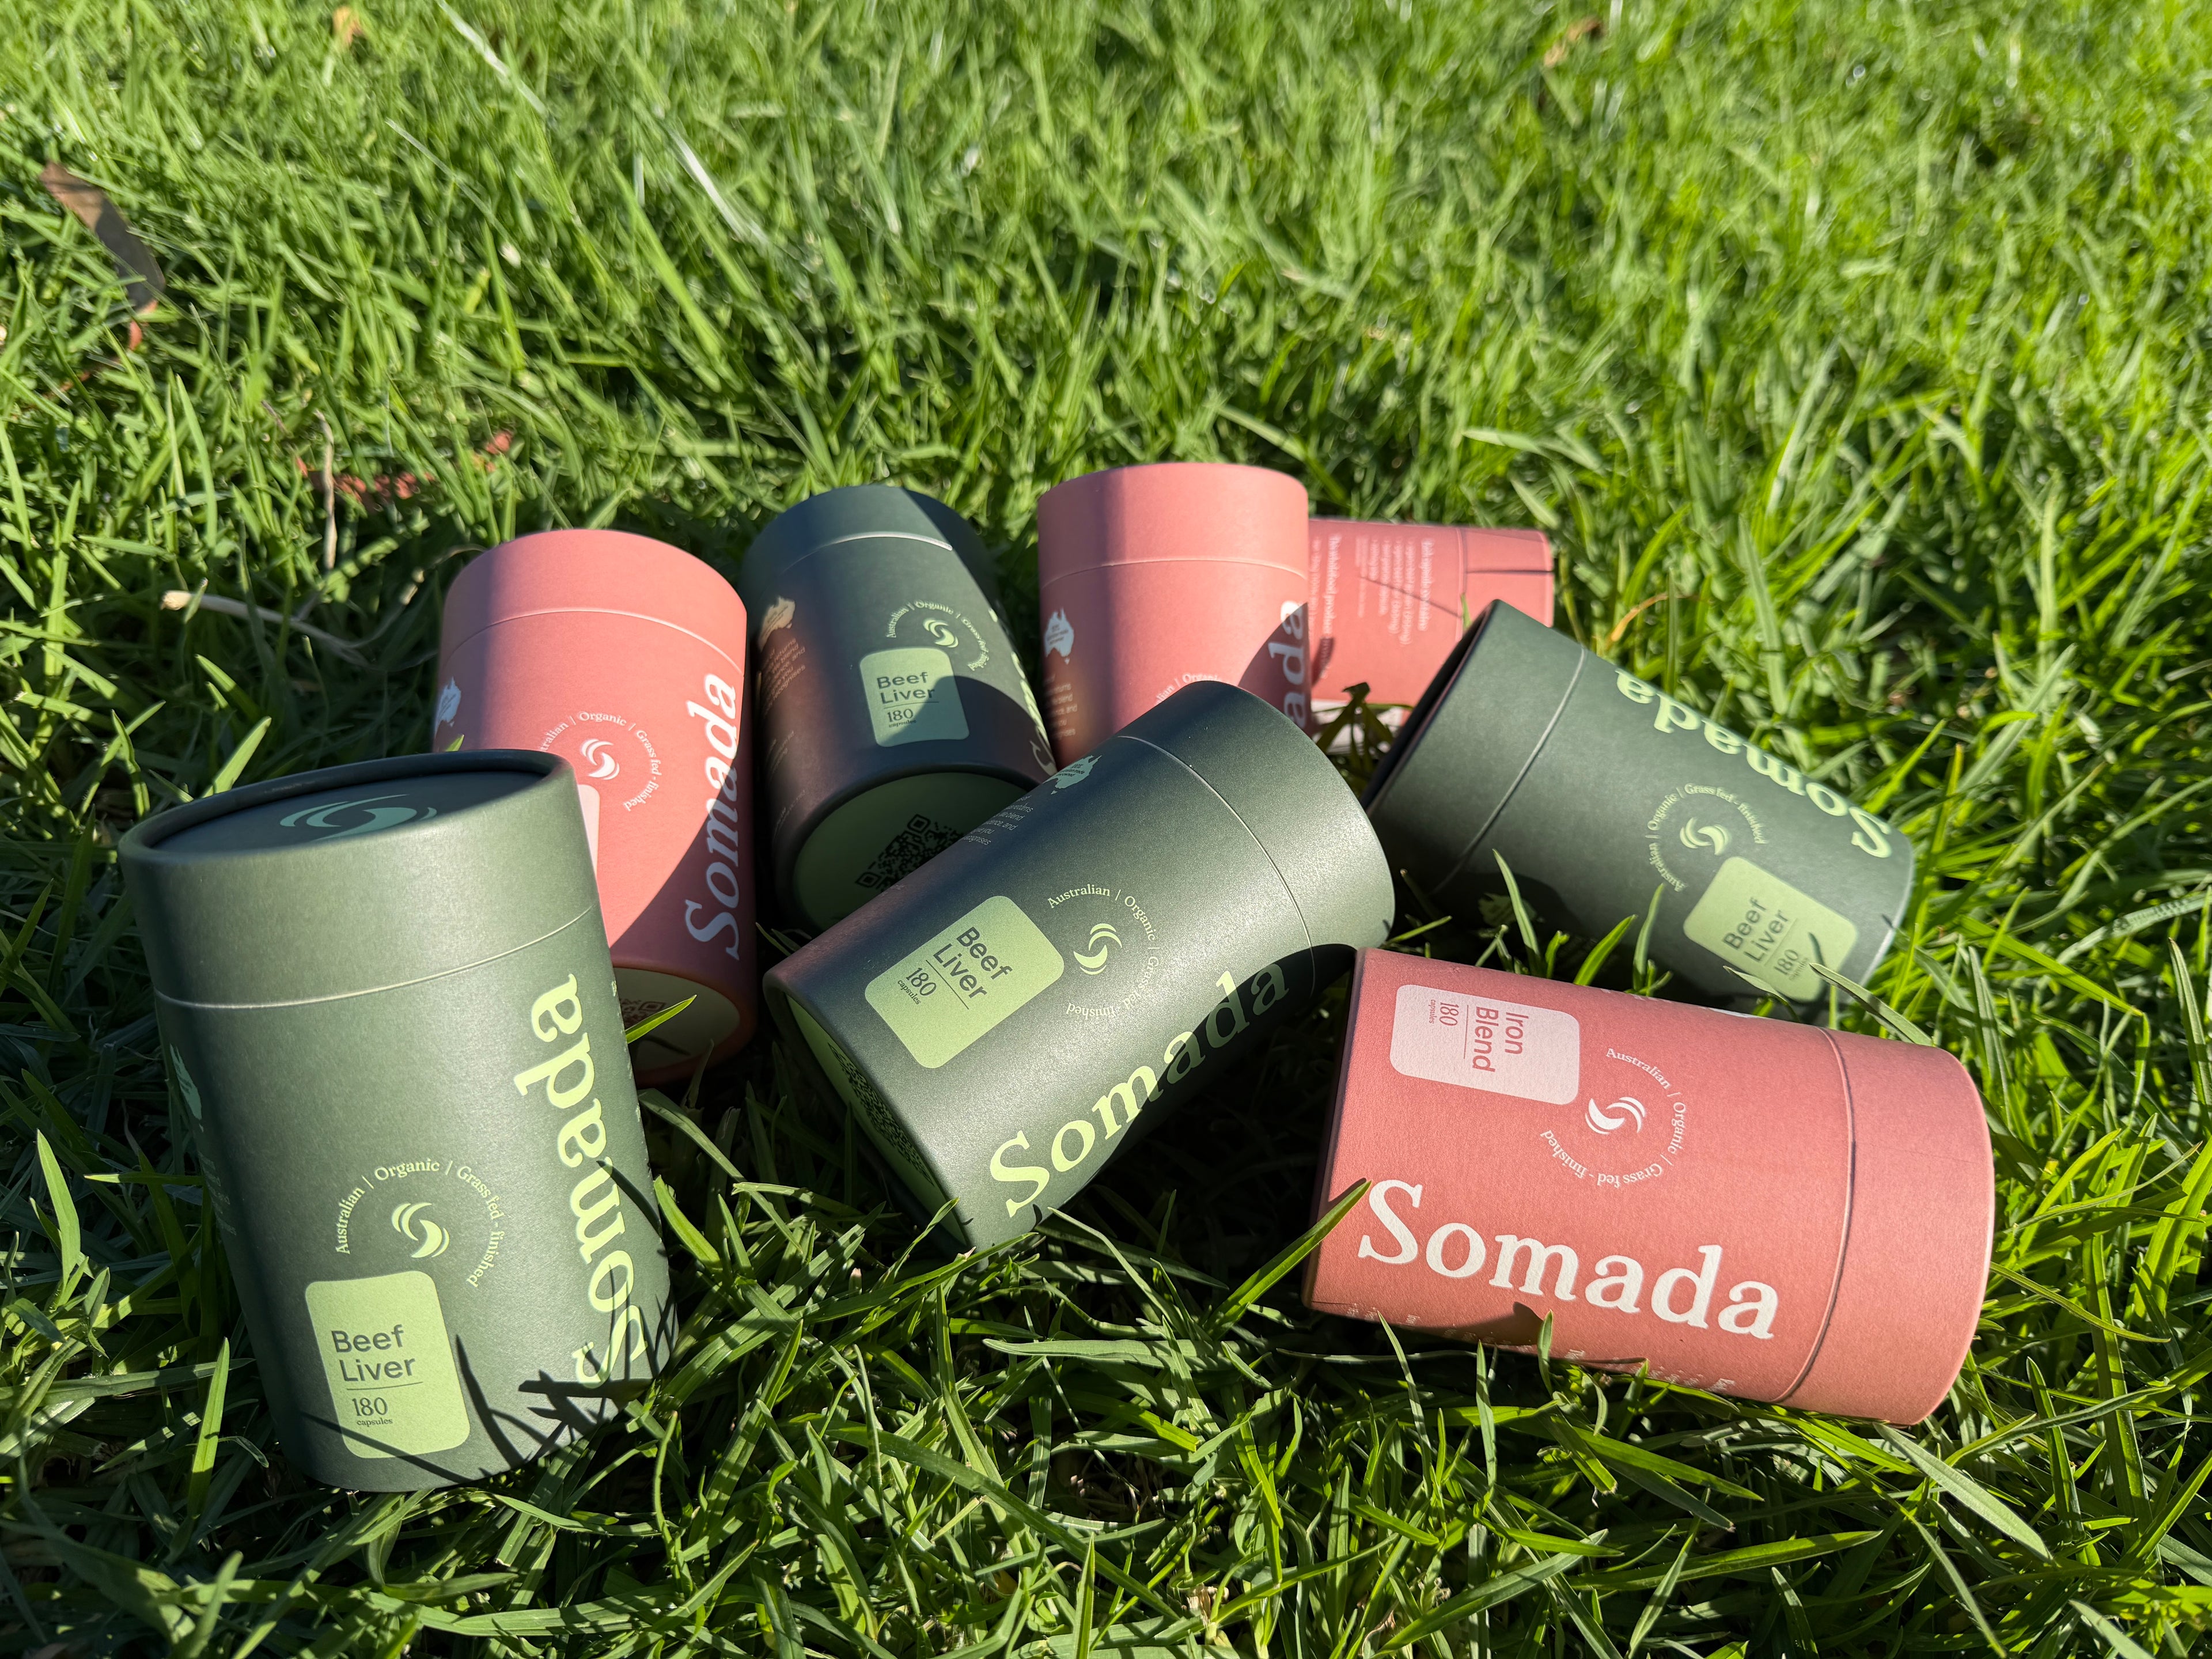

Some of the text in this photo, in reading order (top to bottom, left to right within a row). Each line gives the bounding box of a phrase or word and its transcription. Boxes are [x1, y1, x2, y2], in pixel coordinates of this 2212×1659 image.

[886, 607, 910, 638] Australian
[914, 600, 953, 615] Organic
[877, 672, 928, 690] Beef
[880, 689, 935, 704] Liver
[578, 711, 627, 726] Organic
[887, 709, 914, 722] 180
[636, 730, 657, 758] Grass
[651, 758, 662, 775] fed
[1615, 668, 1893, 859] Somada
[623, 781, 659, 812] finished
[1684, 783, 1717, 795] Grass
[685, 673, 740, 961] Somada
[1647, 793, 1679, 831] Organic
[1649, 842, 1687, 892] Australian
[1047, 884, 1111, 908] Australian
[1124, 896, 1157, 942] Organic
[1722, 896, 1767, 950] Beef
[1744, 909, 1788, 962] Liver
[956, 926, 1013, 980] Beef
[1774, 949, 1799, 975] 180
[906, 967, 937, 997] 180
[933, 943, 987, 999] Liver
[1138, 956, 1159, 990] Grass
[897, 979, 921, 1005] capsules
[1123, 989, 1142, 1007] fed
[1066, 1002, 1116, 1020] finished
[1429, 999, 1437, 1024] capsules
[1439, 1002, 1459, 1026] 180
[1472, 1006, 1499, 1073] Blend
[1505, 1012, 1529, 1054] Iron
[1605, 1048, 1671, 1089] Australian
[990, 963, 1290, 1218] Somada
[1667, 1101, 1687, 1154] Organic
[374, 1158, 440, 1181] Organic
[1540, 1130, 1588, 1180] finished
[457, 1165, 491, 1199] Grass
[513, 972, 649, 1390] Somada
[1597, 1173, 1620, 1188] fed
[1622, 1163, 1662, 1184] Grass
[336, 1187, 365, 1255] Australian
[486, 1195, 505, 1220] fed
[465, 1230, 505, 1288] finished
[1358, 1179, 1779, 1339] Somada
[331, 1324, 404, 1353] Beef
[339, 1358, 416, 1382] Liver
[352, 1396, 388, 1417] 180
[356, 1417, 393, 1427] capsules
